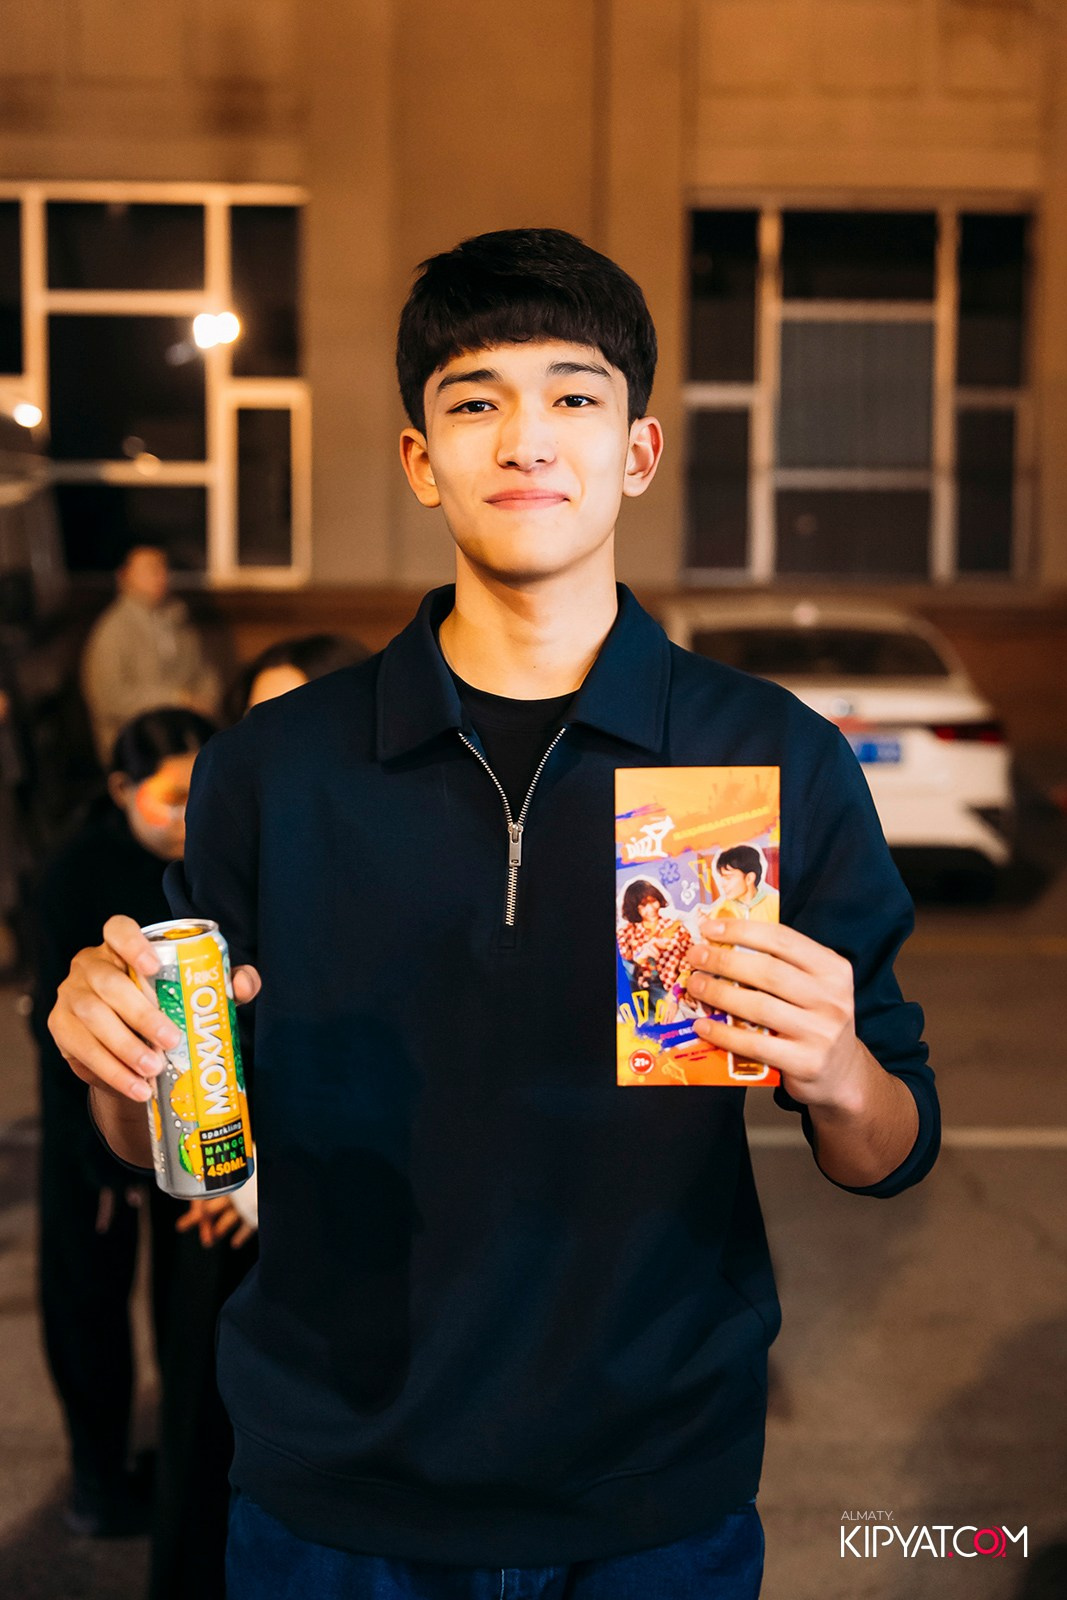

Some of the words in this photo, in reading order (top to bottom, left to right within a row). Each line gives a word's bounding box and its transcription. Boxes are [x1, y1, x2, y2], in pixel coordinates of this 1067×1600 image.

[201, 1121, 242, 1139] sparkling
[205, 1136, 244, 1155] MANGO
[206, 1146, 245, 1166] MINT
[207, 1156, 247, 1177] 450ML
